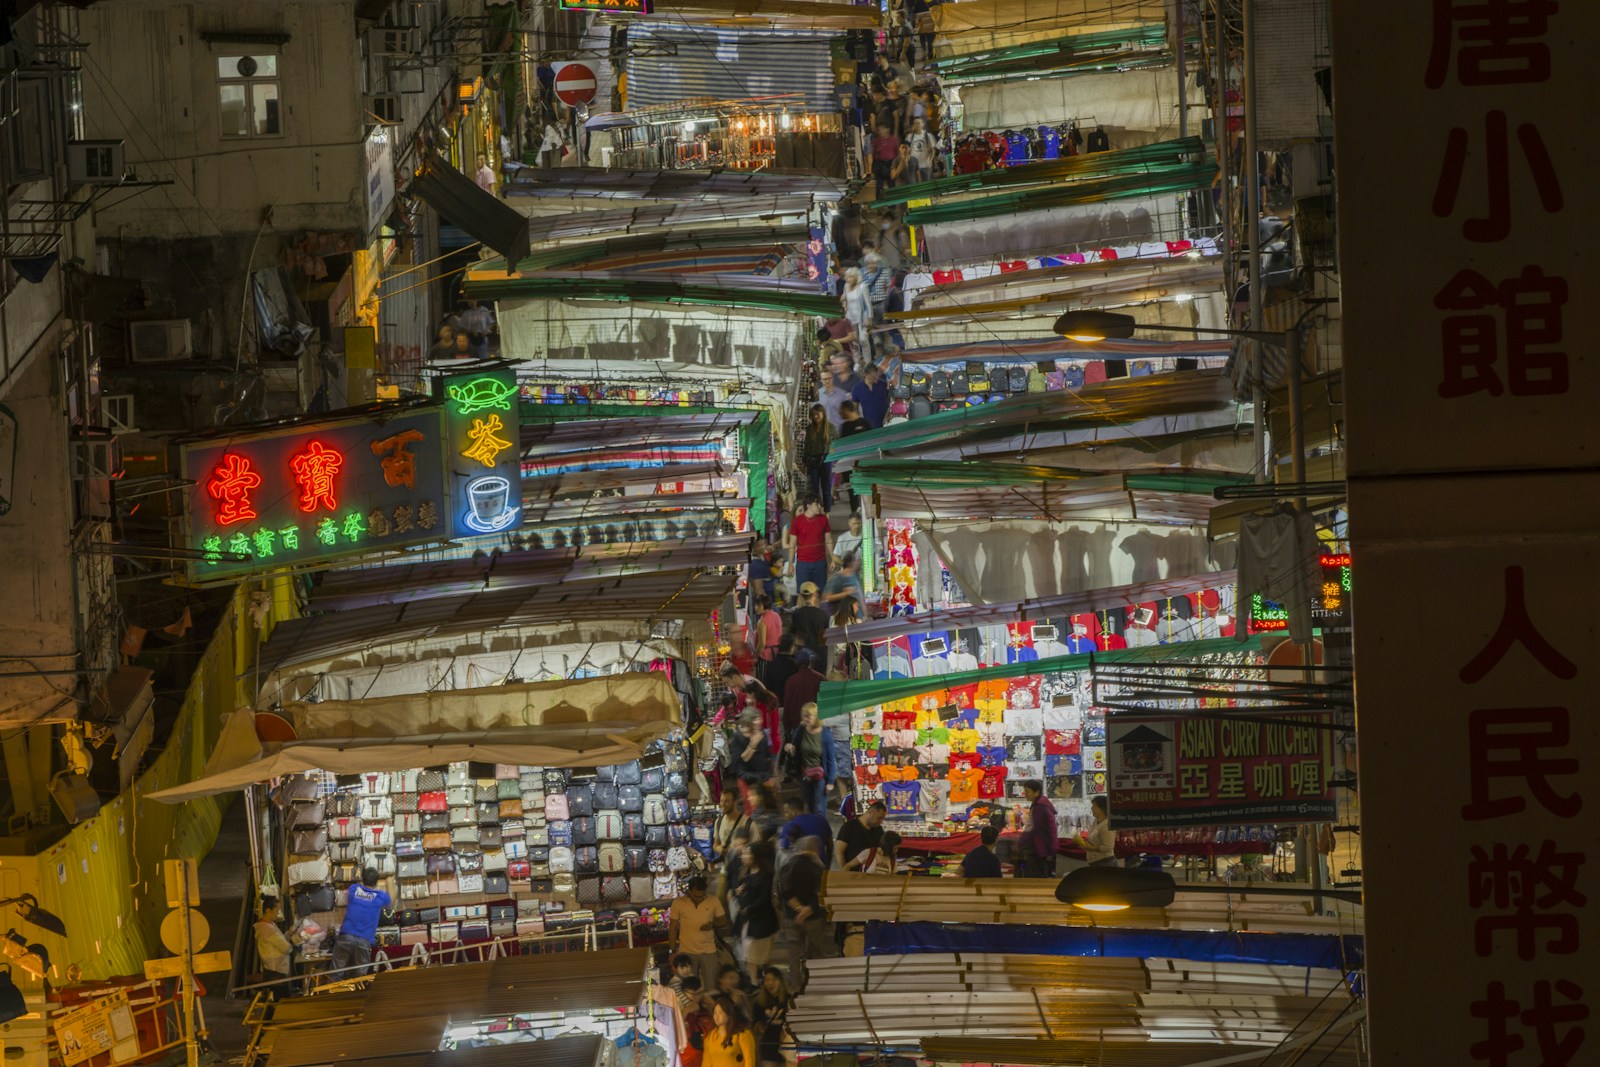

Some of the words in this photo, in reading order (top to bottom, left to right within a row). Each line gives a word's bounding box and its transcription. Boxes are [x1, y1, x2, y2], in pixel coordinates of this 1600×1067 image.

[1179, 719, 1216, 759] ASIAN
[1221, 718, 1261, 758] CURRY
[1267, 715, 1319, 756] KITCHEN
[1179, 760, 1322, 798] 亞星咖喱
[1229, 808, 1243, 816] Food
